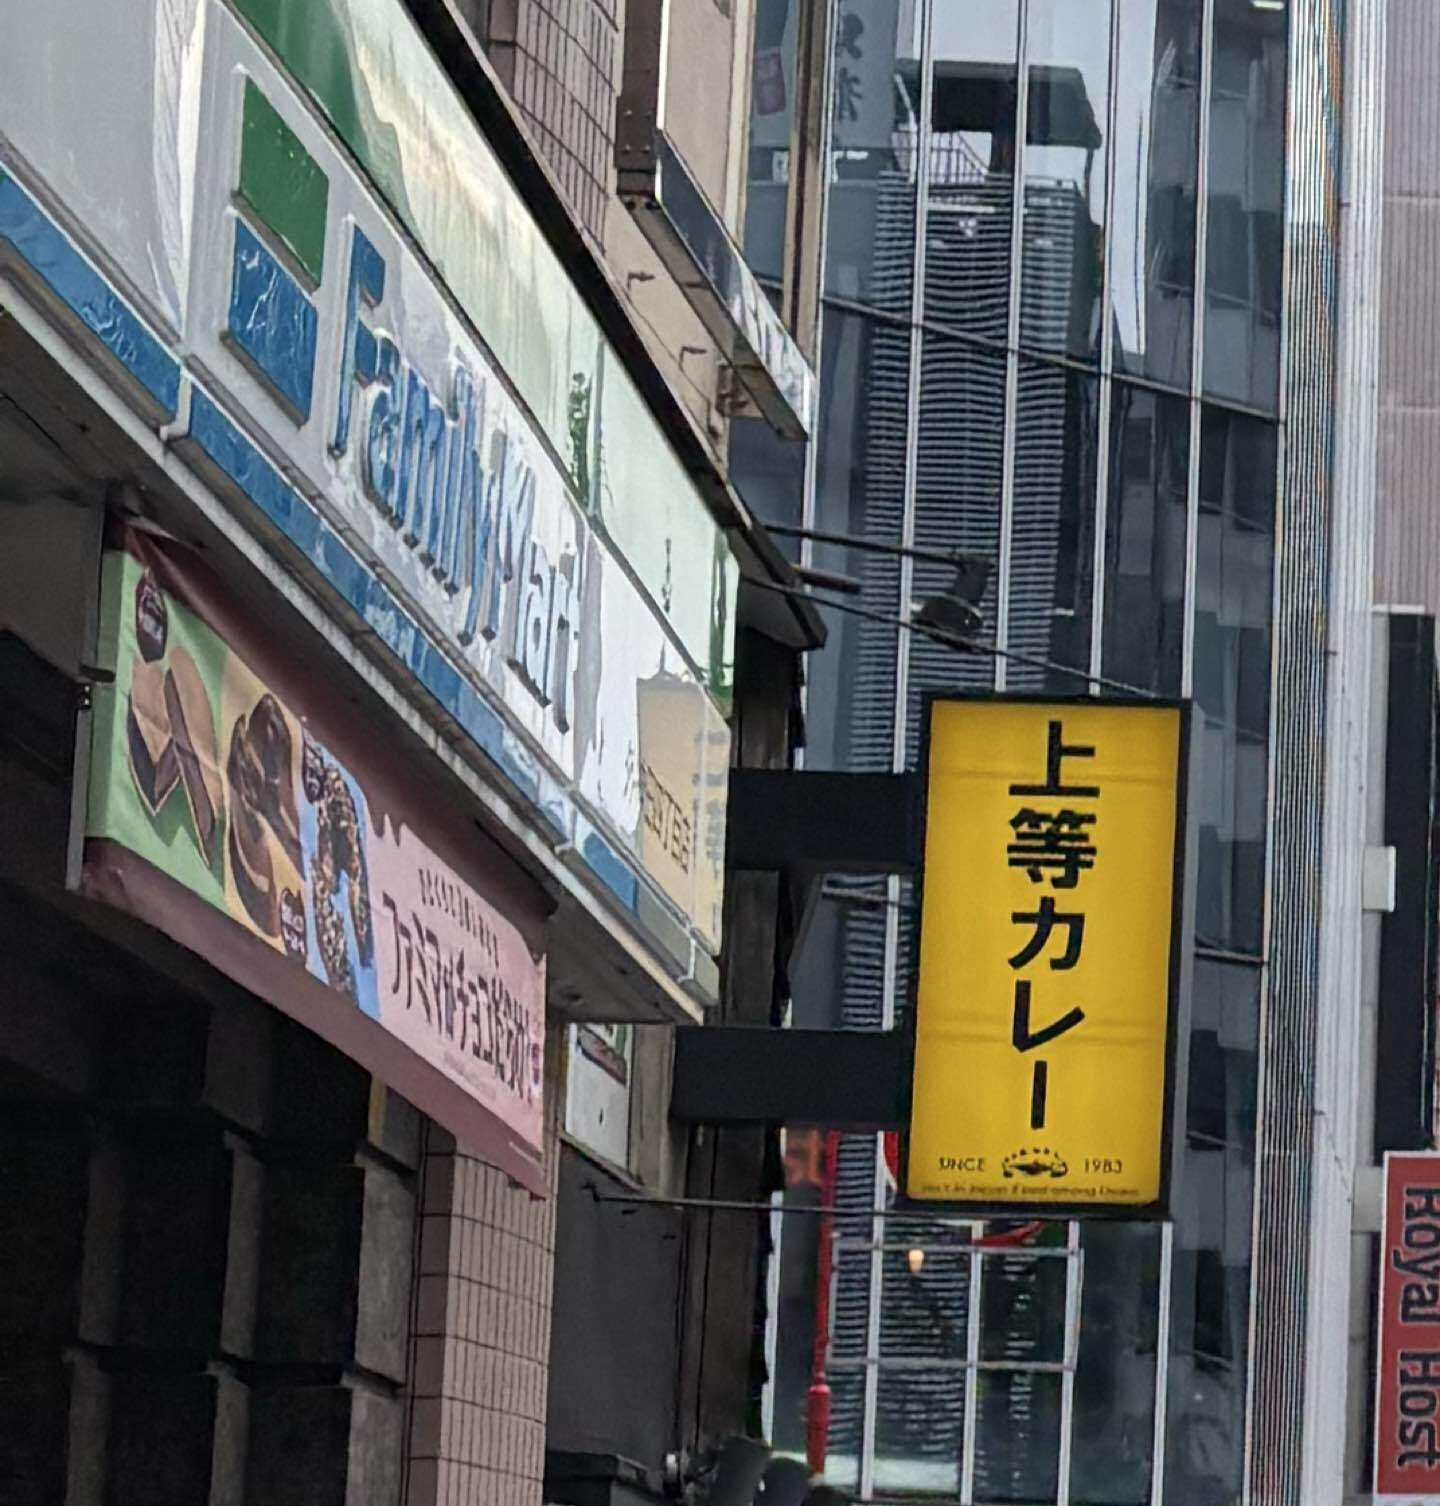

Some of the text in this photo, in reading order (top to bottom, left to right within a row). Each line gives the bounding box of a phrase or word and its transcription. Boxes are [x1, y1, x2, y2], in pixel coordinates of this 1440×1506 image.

[1007, 720, 1099, 1130] 上等カレー
